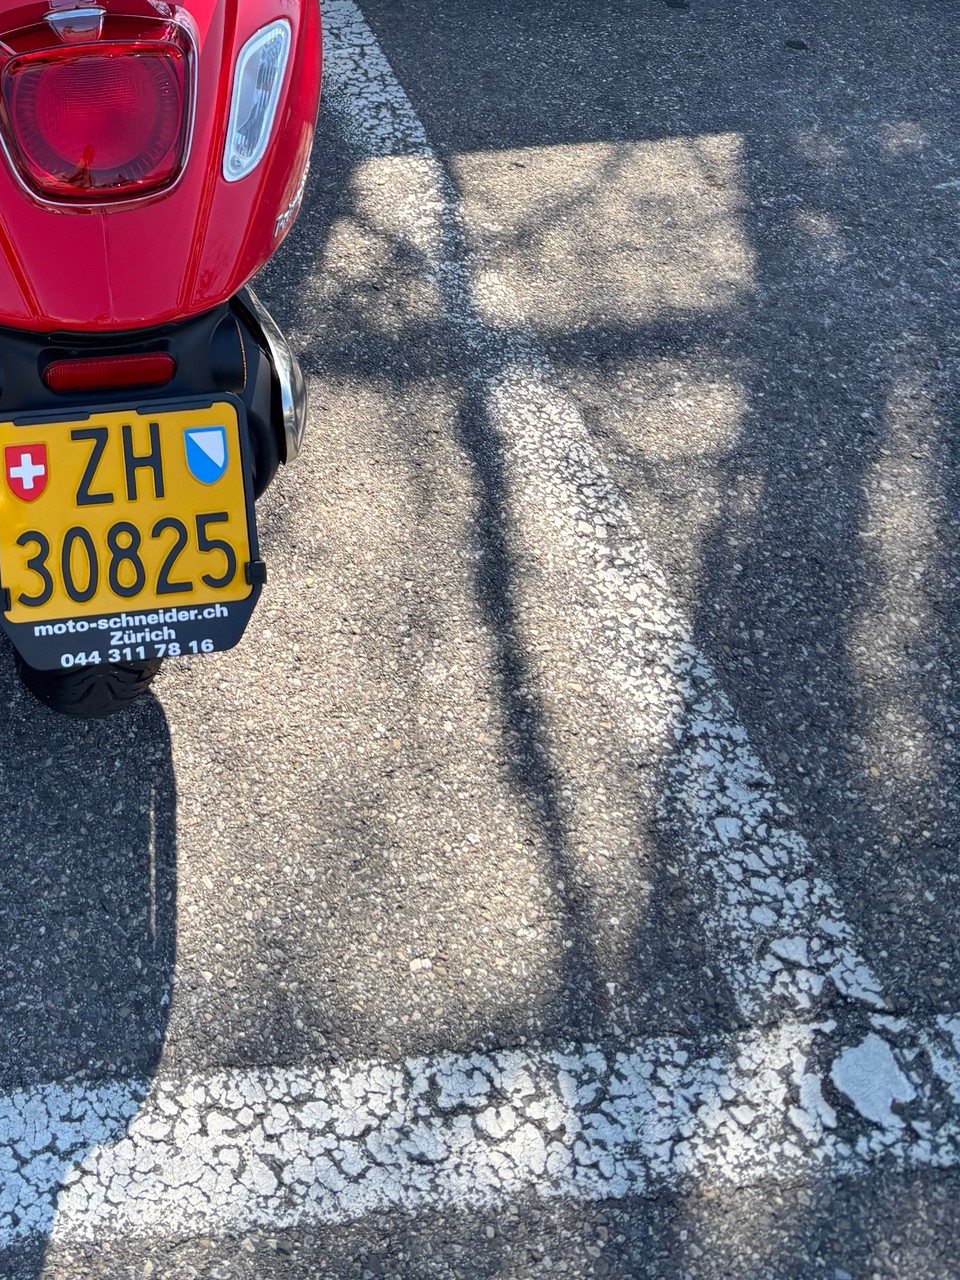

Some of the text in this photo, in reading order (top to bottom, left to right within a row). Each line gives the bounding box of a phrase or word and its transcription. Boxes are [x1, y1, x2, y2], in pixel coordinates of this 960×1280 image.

[70, 422, 166, 507] ZH
[16, 511, 237, 607] 30825
[34, 603, 229, 637] moto-schneider.ch
[110, 627, 176, 646] Zürich
[60, 638, 215, 669] 044 311 78 16
